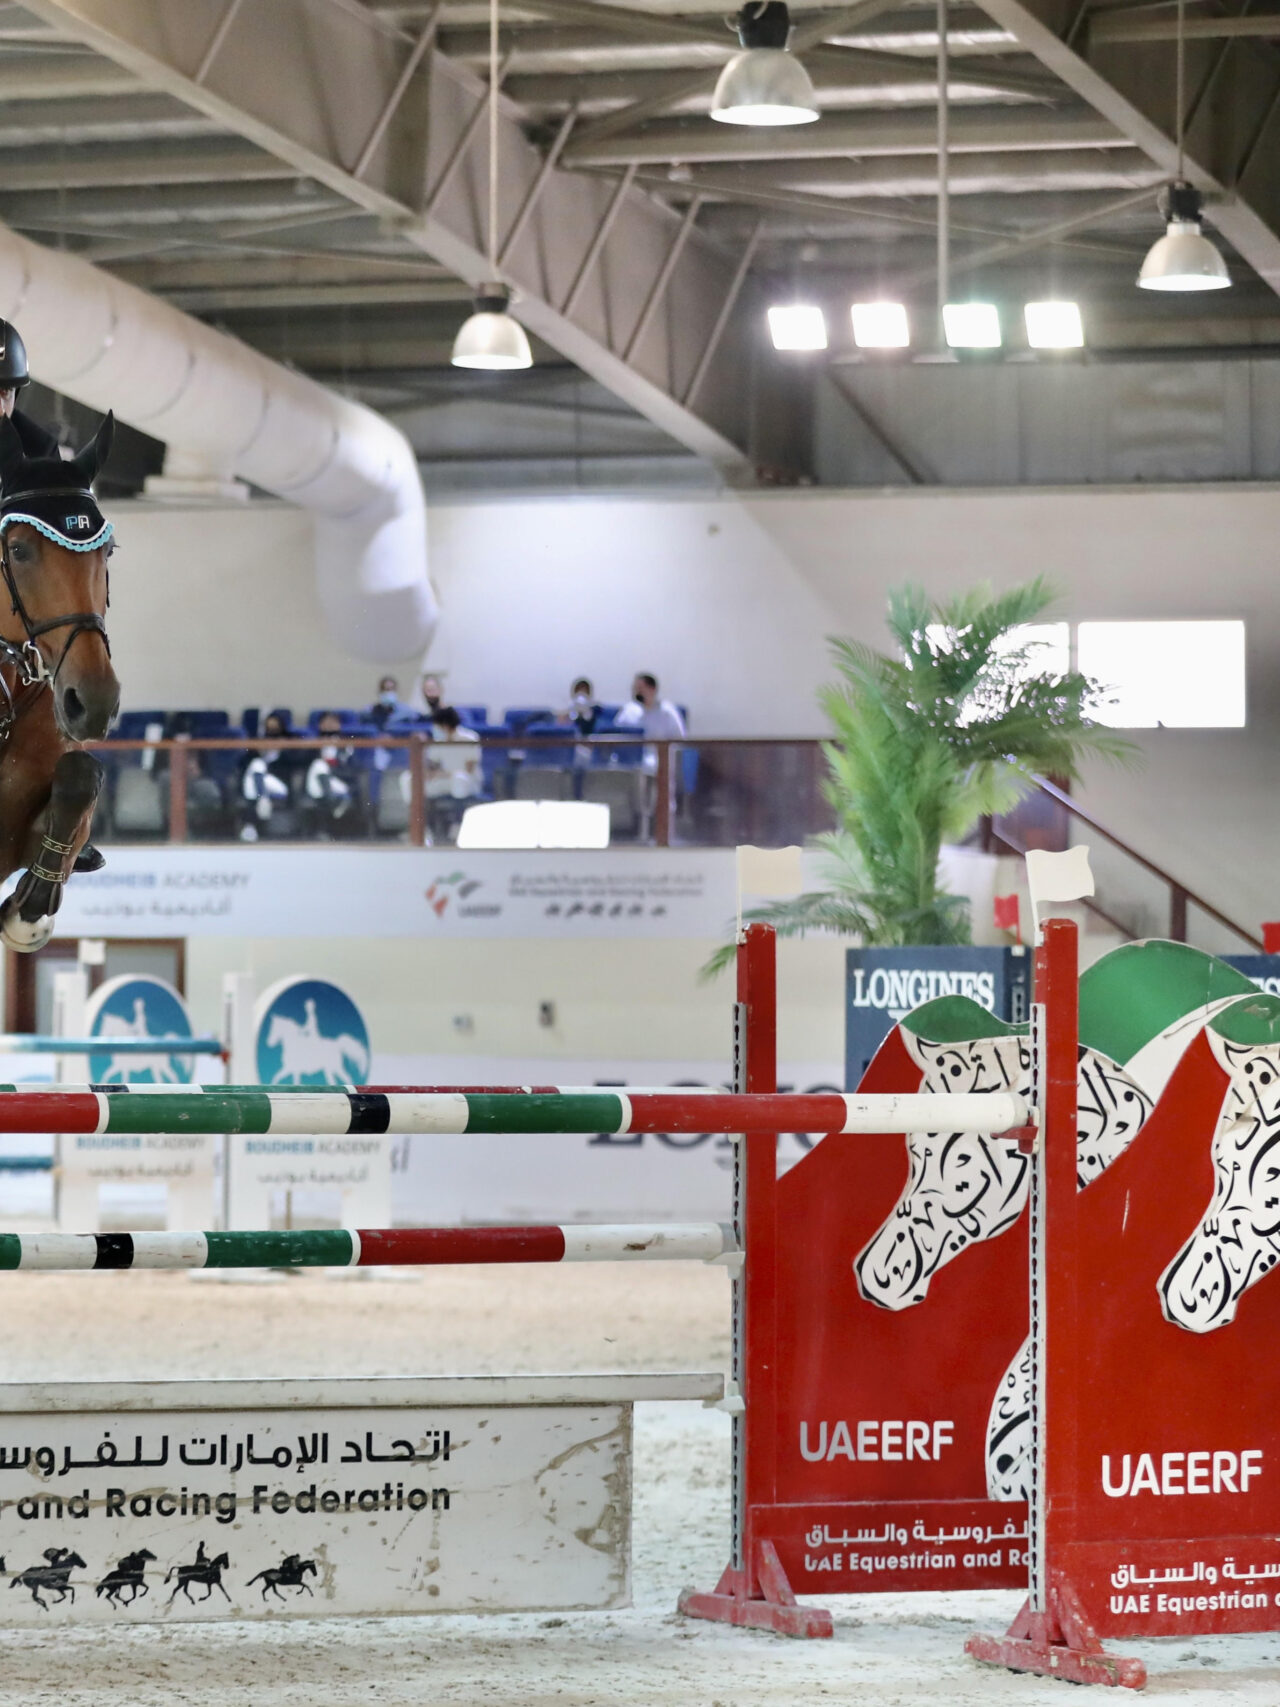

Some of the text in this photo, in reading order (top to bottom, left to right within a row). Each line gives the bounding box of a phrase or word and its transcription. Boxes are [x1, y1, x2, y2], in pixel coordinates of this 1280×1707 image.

[853, 968, 995, 1012] LONGINES
[179, 1432, 329, 1473] الإمارات
[340, 1430, 450, 1464] اتحاد
[799, 1420, 954, 1462] UAEERF
[1101, 1450, 1263, 1497] UAEERF
[17, 1489, 90, 1519] and
[106, 1487, 237, 1524] Racing
[253, 1482, 451, 1514] Federation
[805, 1518, 1029, 1548] لفروسية والسباق
[804, 1553, 842, 1571] UAE
[849, 1551, 956, 1573] Equestrian
[963, 1550, 1001, 1567] and
[1110, 1562, 1218, 1589] والسباق
[1110, 1595, 1150, 1614] UAE
[1157, 1590, 1268, 1616] Equestrian
